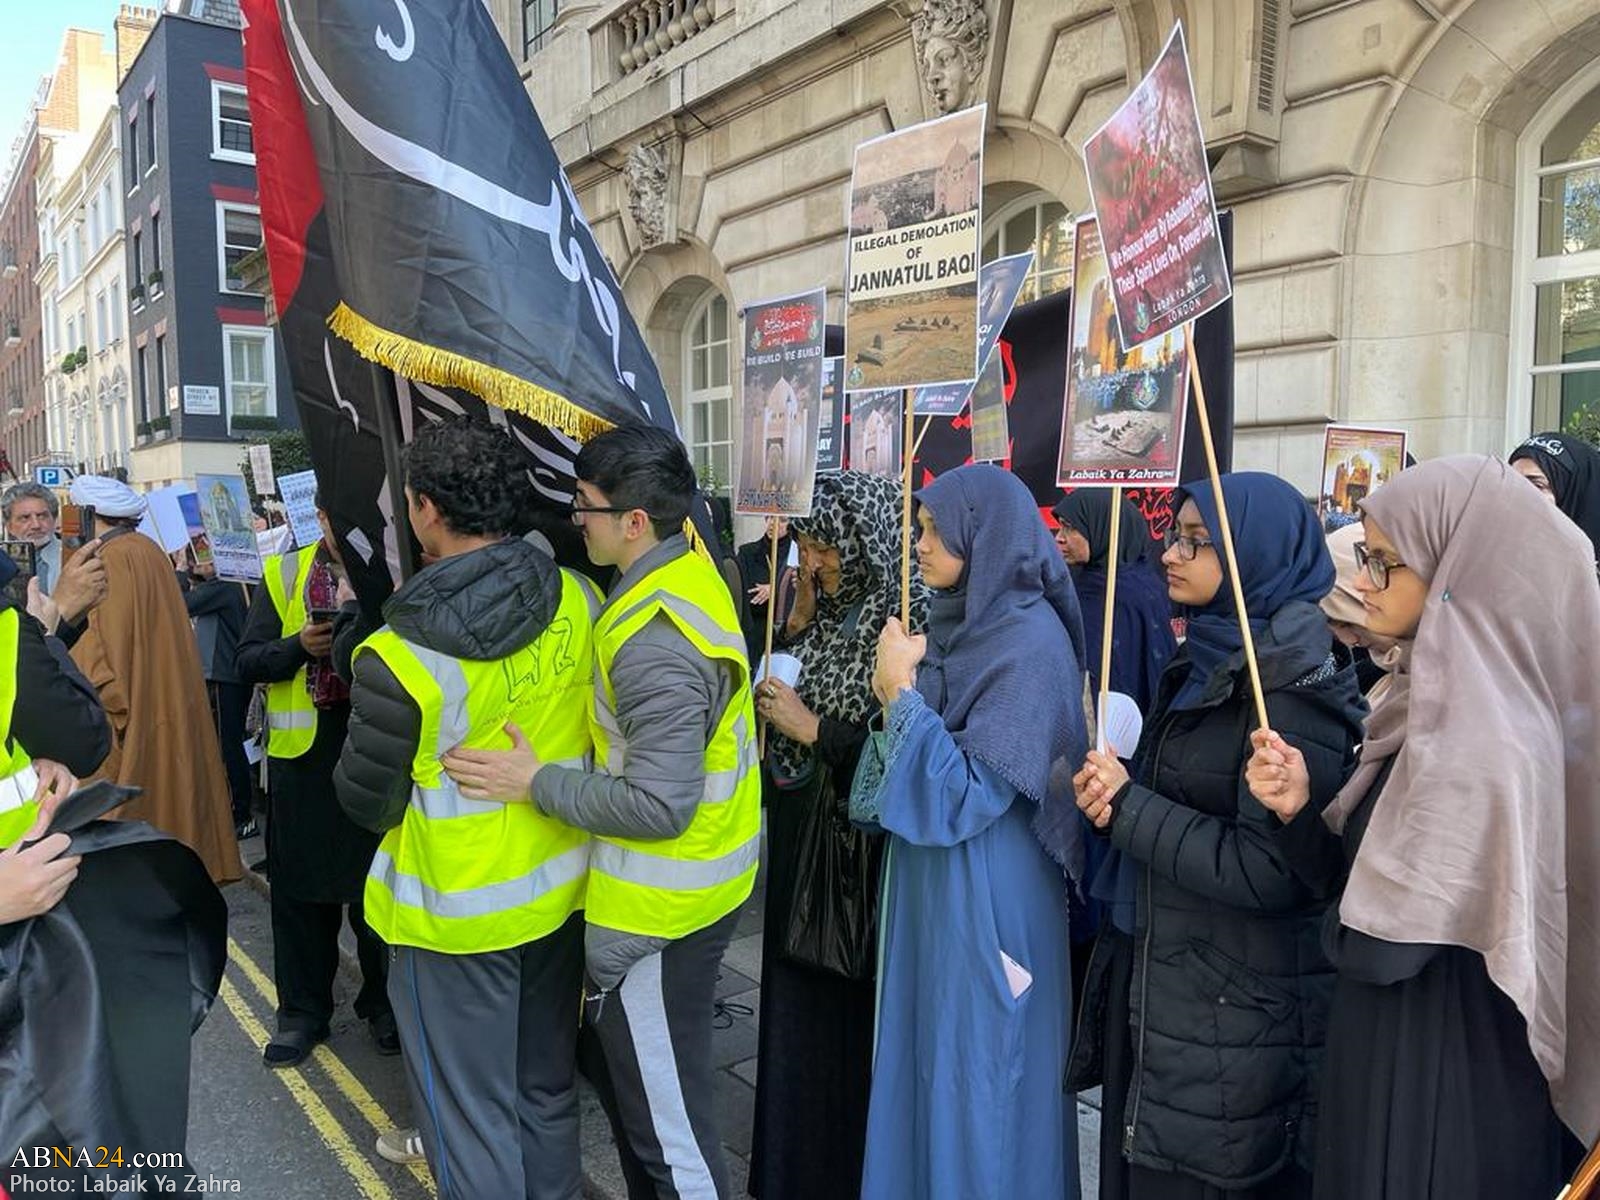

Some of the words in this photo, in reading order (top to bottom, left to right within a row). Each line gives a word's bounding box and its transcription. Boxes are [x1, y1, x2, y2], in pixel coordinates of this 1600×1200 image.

[854, 234, 899, 253] ILLEGAL
[900, 215, 976, 244] DEMOLATION
[906, 246, 922, 260] OF
[850, 262, 933, 293] JANNATUL
[937, 252, 976, 279] BAQI
[1167, 297, 1202, 324] LONDON
[45, 471, 57, 483] P
[1069, 469, 1107, 479] Labaik
[1109, 469, 1124, 479] Ya
[1127, 468, 1164, 479] Zahra
